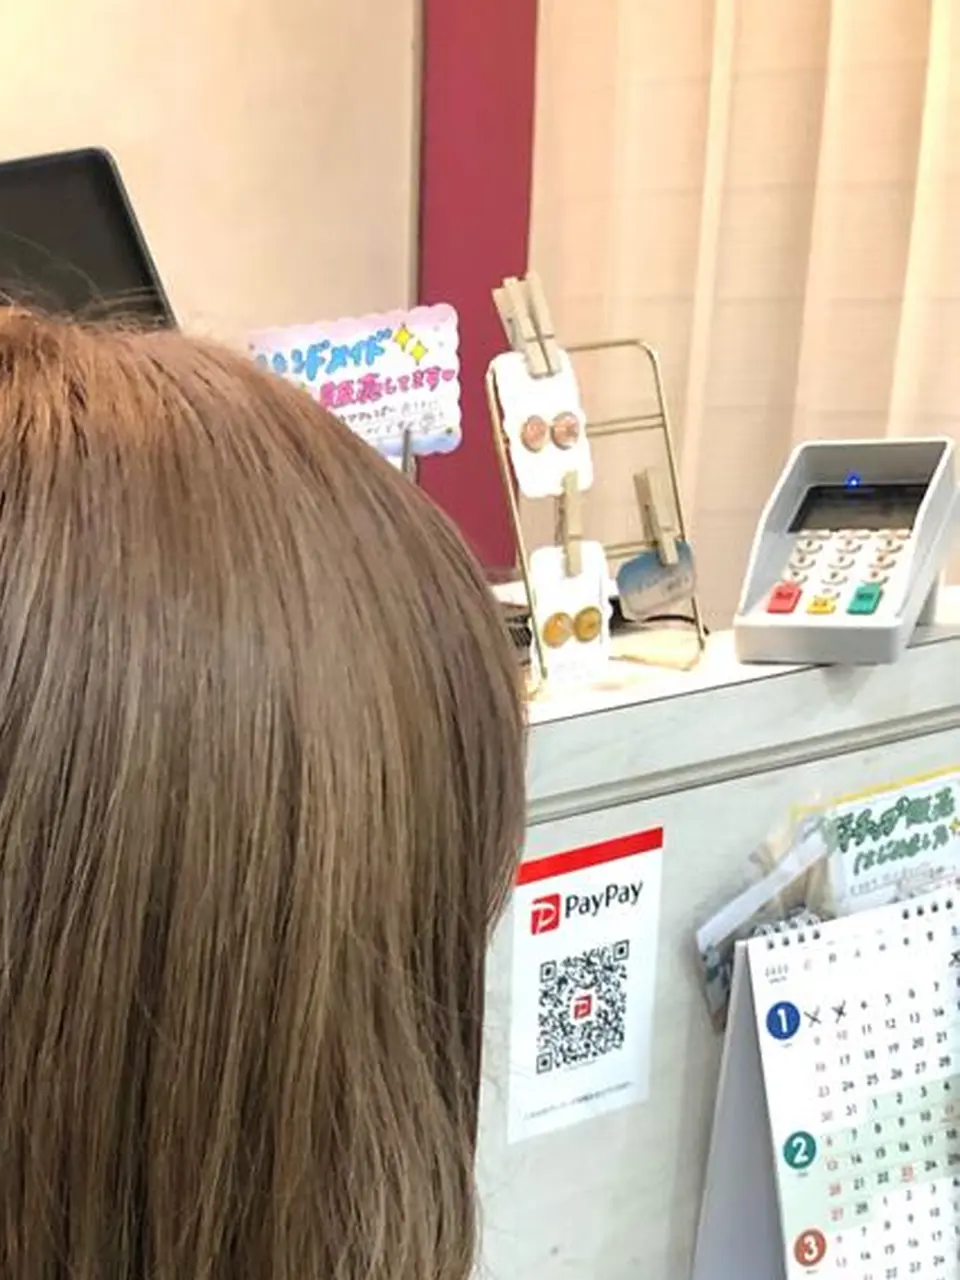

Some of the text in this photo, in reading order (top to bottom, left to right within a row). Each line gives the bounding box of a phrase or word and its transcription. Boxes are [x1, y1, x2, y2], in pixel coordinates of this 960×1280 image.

[565, 880, 643, 918] PayPay
[792, 1136, 809, 1164] 2
[803, 1234, 819, 1262] 3
